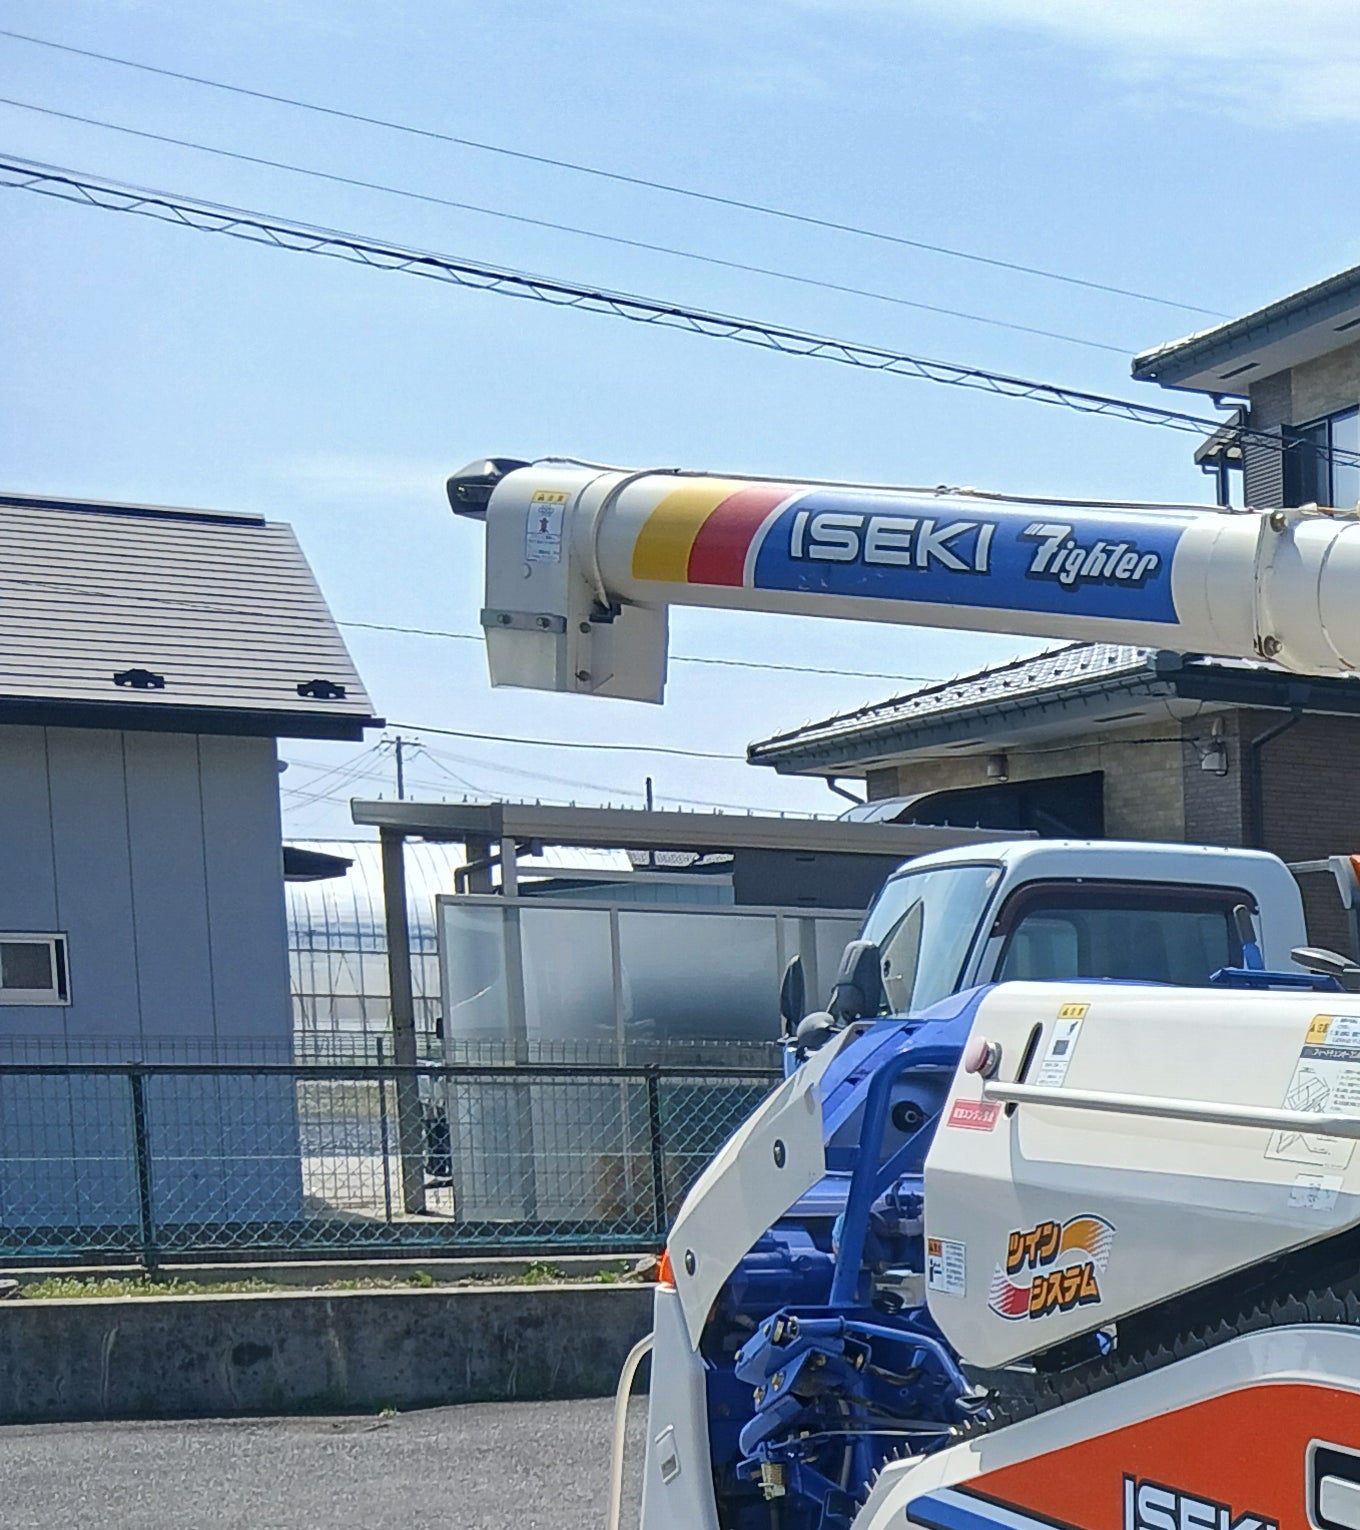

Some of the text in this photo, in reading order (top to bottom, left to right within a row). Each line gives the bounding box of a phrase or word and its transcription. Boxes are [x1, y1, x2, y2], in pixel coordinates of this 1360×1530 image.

[789, 509, 992, 573] ISEKI
[1006, 1221, 1061, 1274] ツイン
[1029, 1262, 1102, 1319] システム
